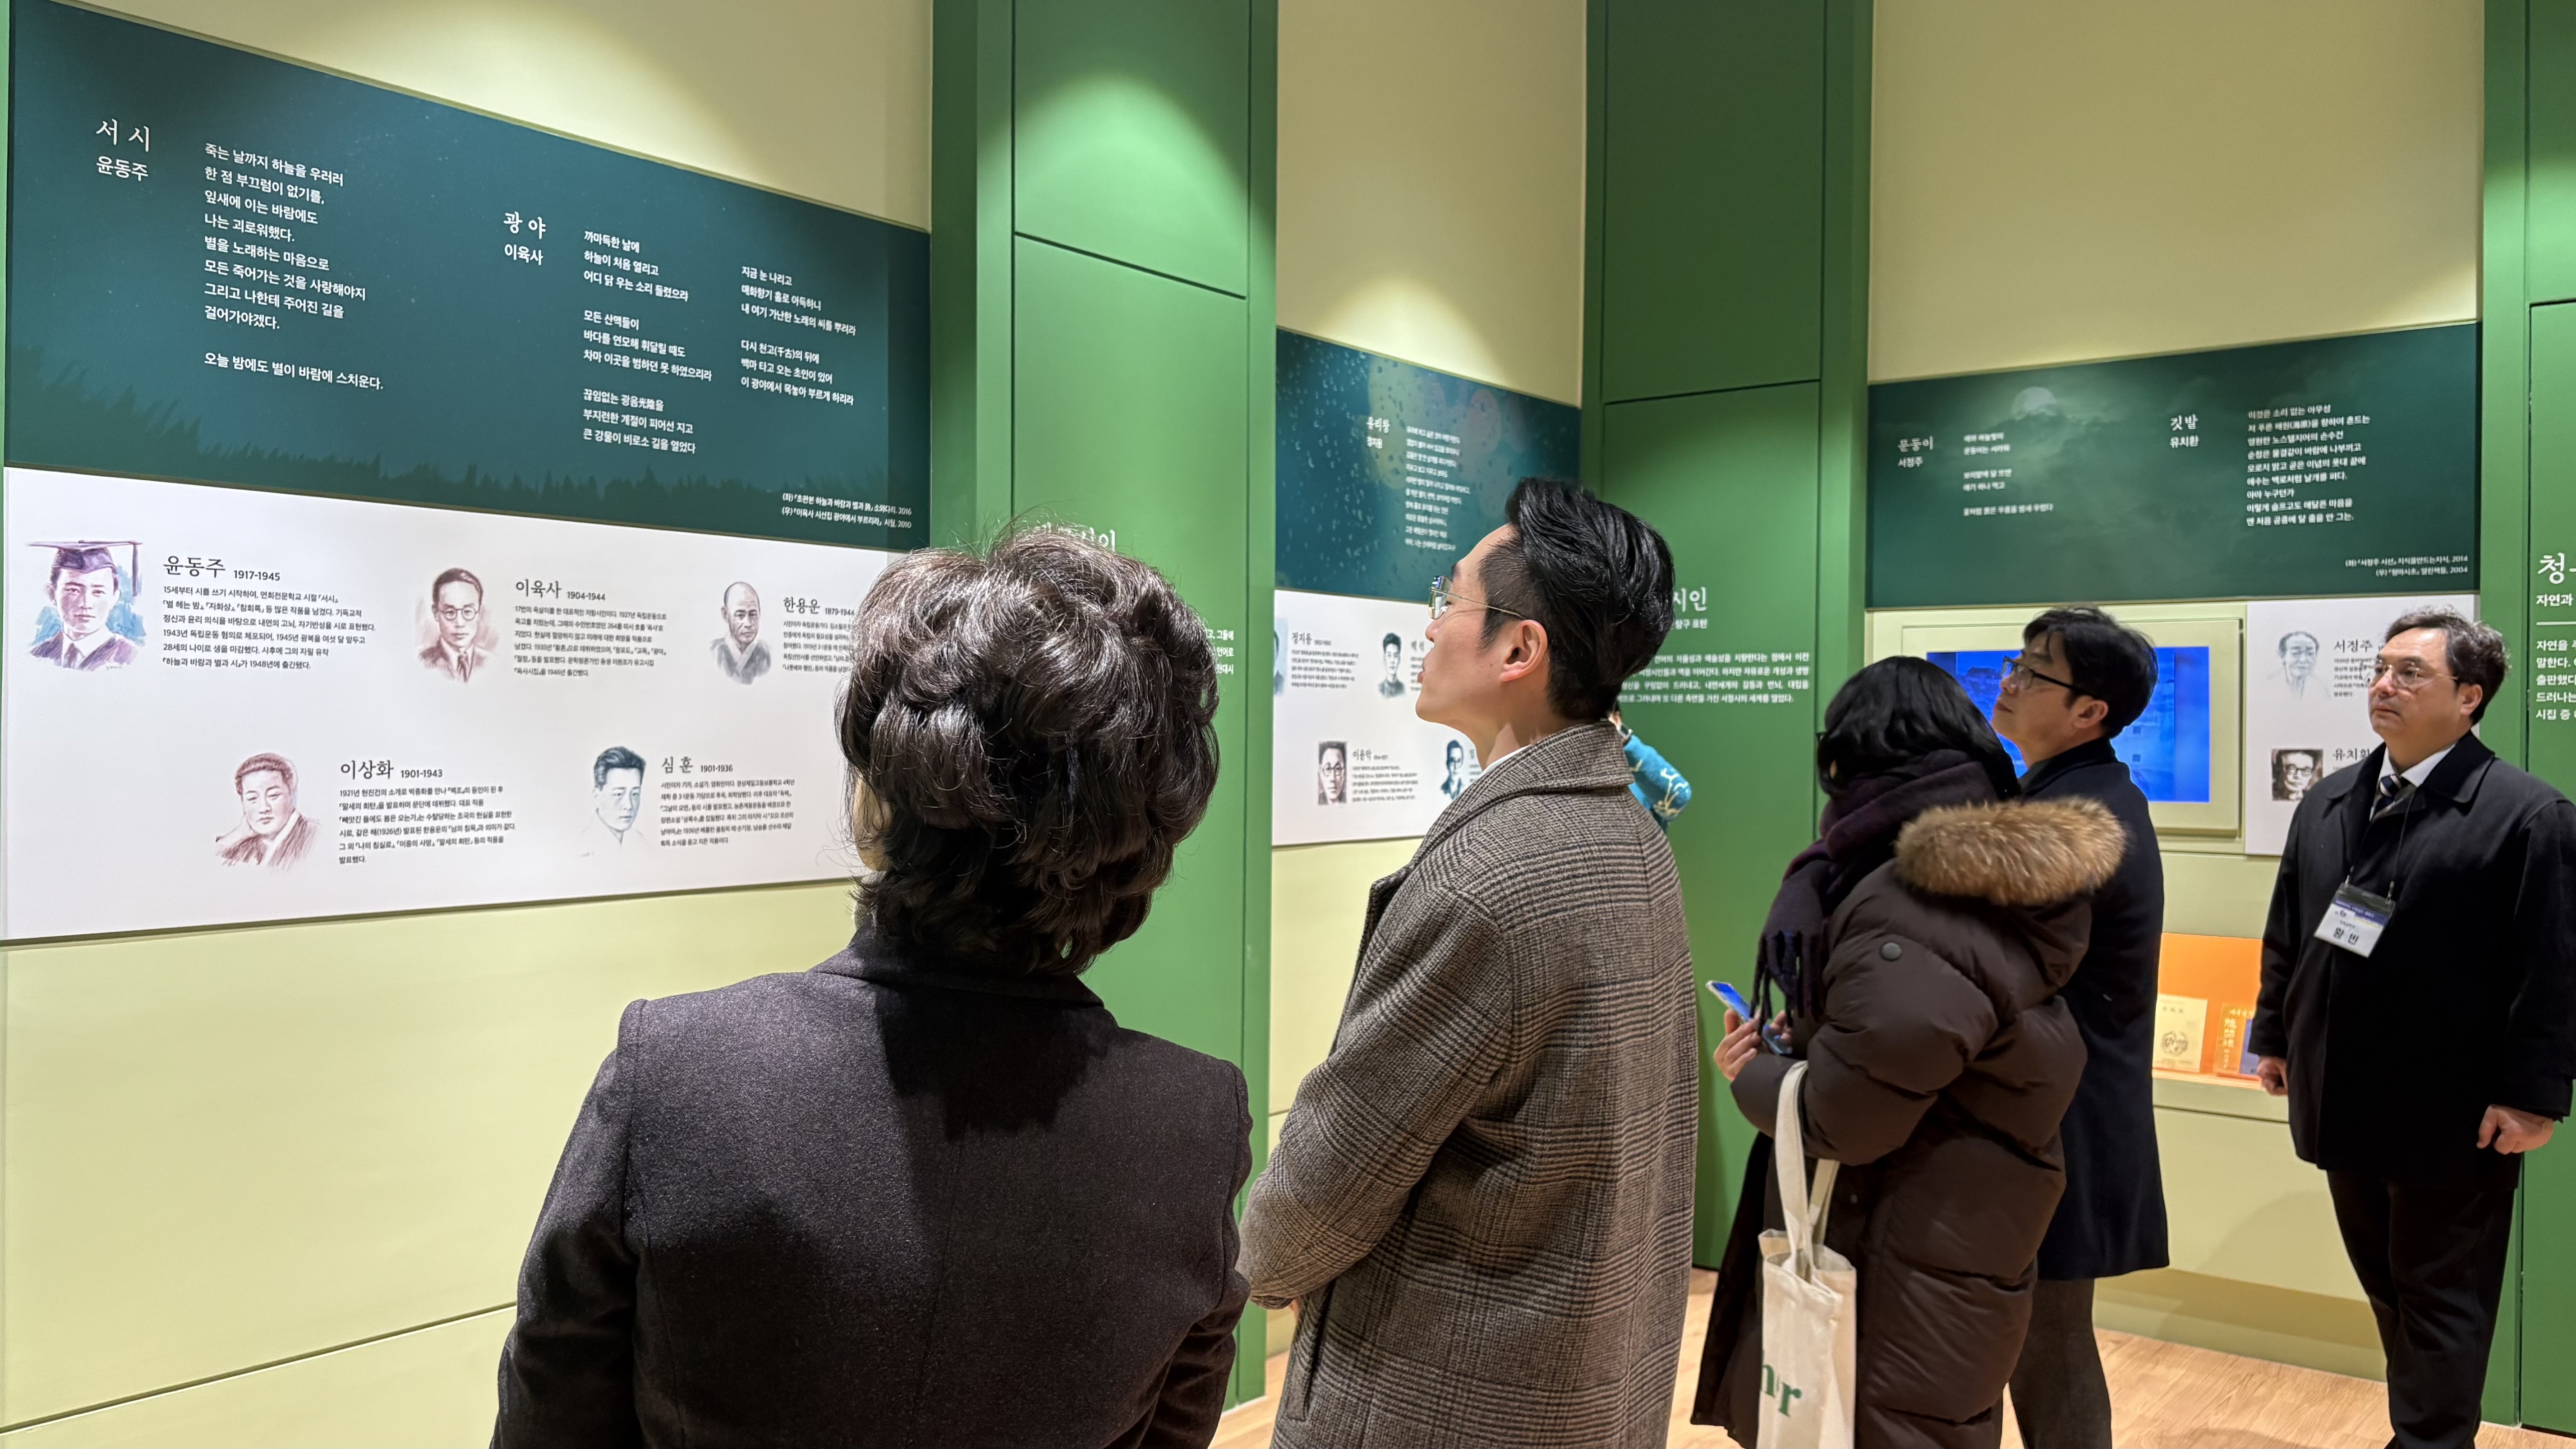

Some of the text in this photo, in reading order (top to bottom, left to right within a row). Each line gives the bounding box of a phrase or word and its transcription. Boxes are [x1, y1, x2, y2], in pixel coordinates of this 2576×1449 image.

[96, 119, 149, 152] 서 시
[97, 156, 148, 181] 윤동주
[205, 143, 343, 187] 죽는 날까지 하늘을 우러러
[205, 166, 324, 204] 한 점 부끄럼이 없기를,
[205, 190, 318, 224] 잎새에 이는 바람에도
[205, 213, 294, 242] 나는 괴로워했다.
[504, 212, 546, 239] 광 야
[584, 230, 639, 253] 까마득한 날에
[205, 236, 329, 271] 별을 노래하는 마음으로
[505, 244, 543, 266] 이육사
[584, 250, 658, 276] 하늘이 처음 열리고
[204, 259, 365, 301] 모든 죽어가는 것을 사랑해야지
[584, 270, 602, 285] 어디
[605, 274, 614, 287] 닭
[616, 277, 634, 290] 우는
[635, 281, 653, 295] 소리
[742, 266, 792, 286] 지금 눈 나리고
[204, 283, 344, 318] 그리고 나한테 주어진 길을
[741, 285, 821, 311] 매화향기 홀로 아득하니
[205, 305, 280, 330] 걸어가야겠다.
[584, 310, 639, 331] 모든 산맥들이
[741, 303, 749, 314] 내
[751, 305, 767, 318] 여기
[769, 308, 792, 323] 가난한
[794, 314, 816, 328] 노래의
[818, 319, 832, 331] 씨를
[584, 330, 685, 357] 바다를 연모해 휘달릴 때도
[741, 340, 757, 352] 다시
[805, 351, 819, 364] 뒤에
[584, 349, 602, 363] 차마
[604, 353, 630, 368] 이곳을
[204, 352, 383, 390] 오늘 밤에도 별이 바람에 스치운다.
[741, 358, 832, 385] 백마 타고 오는 초인이 있어
[584, 389, 619, 405] 끊임없는
[741, 377, 854, 406] 이 광야에서 목놓아 부르게 하리라
[583, 409, 693, 434] 부지런한 계절이 피어선 지고
[2171, 414, 2198, 431] 깃발
[584, 428, 695, 454] 큰 강물이 비로소 길을 열었다
[2170, 435, 2199, 448] 유치환
[898, 520, 911, 529] 2010
[163, 556, 225, 578] 윤동주
[234, 570, 280, 581] 1917-1945
[164, 586, 258, 599] 15세부터 시를 시작하여,
[516, 579, 561, 599] 이육사
[567, 591, 605, 601] 1904-1944
[784, 596, 820, 615] 한용운
[2536, 593, 2573, 607] 자연과
[163, 614, 346, 630] 정신과 바탕으로 내면의 시로
[164, 629, 188, 638] 1943년
[1292, 632, 1312, 645] 정지용
[164, 643, 260, 654] 28세의 나이로 마감했다.
[2334, 639, 2373, 653] 서정주
[2537, 639, 2568, 651] 자연을
[250, 660, 280, 668] 1948년에
[2537, 657, 2571, 668] 말한다.
[2536, 708, 2570, 720] 시집 중
[341, 759, 394, 780] 이상화
[401, 769, 442, 778] 1901-1943
[662, 756, 693, 774] 심 훈
[340, 789, 359, 797] 1921년
